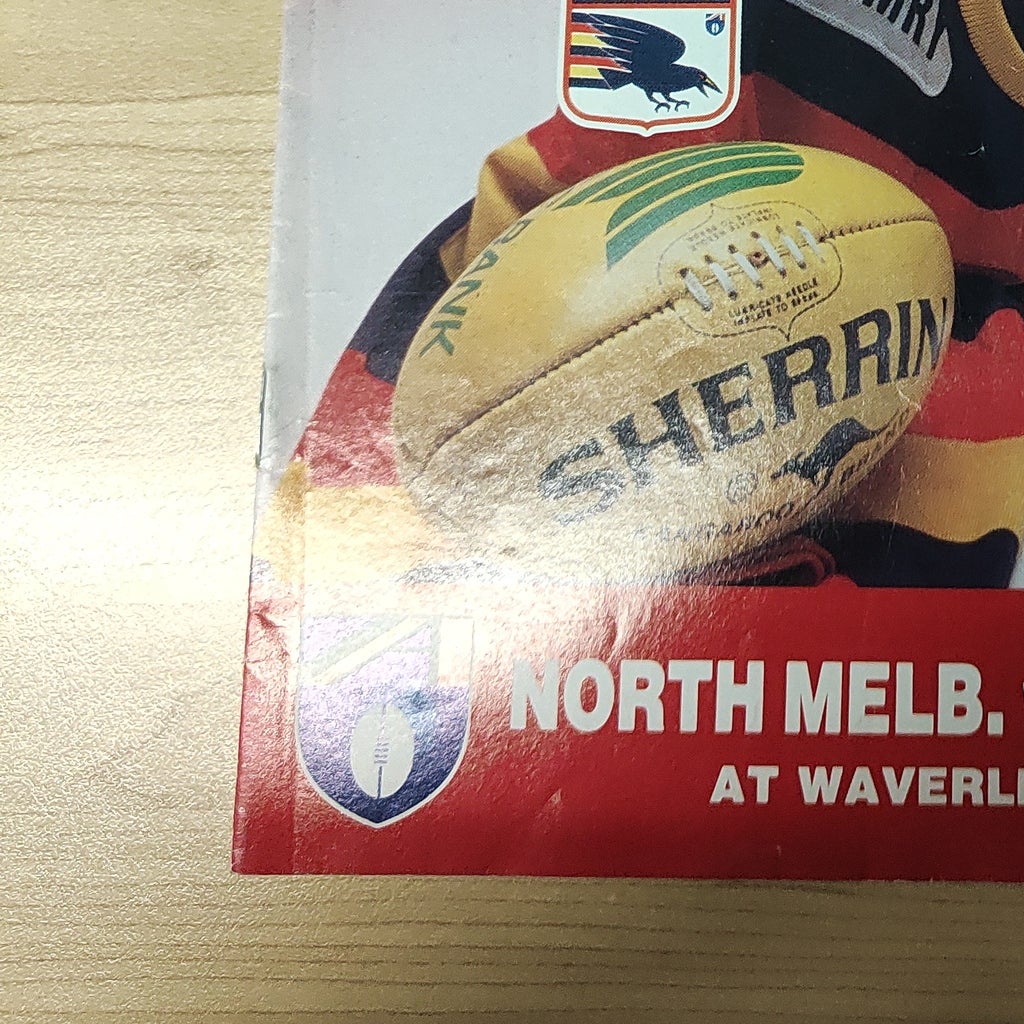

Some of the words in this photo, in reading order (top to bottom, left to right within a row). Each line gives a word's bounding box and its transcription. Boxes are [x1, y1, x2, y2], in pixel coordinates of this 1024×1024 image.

[536, 296, 948, 530] SHERRIN
[509, 660, 763, 733] NORTH
[784, 662, 1004, 737] MELB.
[709, 765, 779, 804] AT
